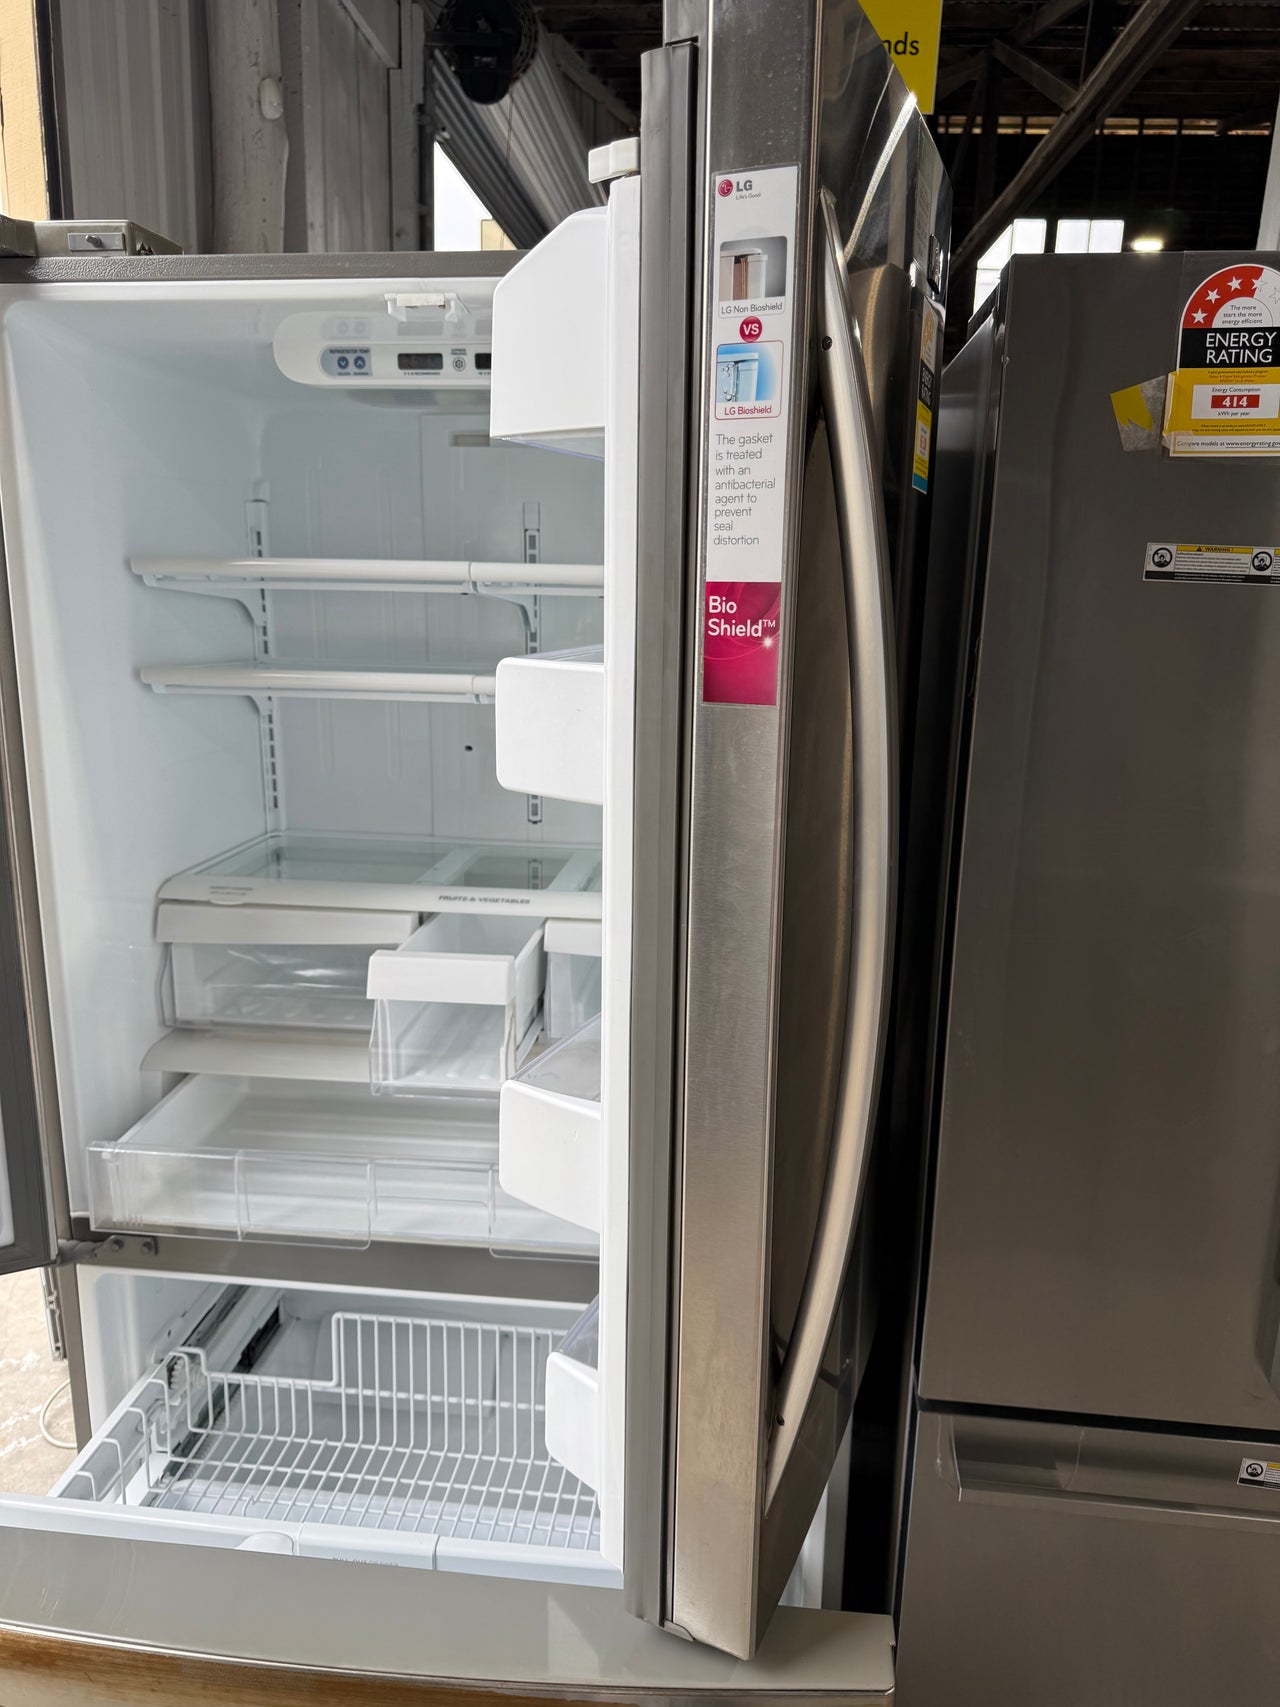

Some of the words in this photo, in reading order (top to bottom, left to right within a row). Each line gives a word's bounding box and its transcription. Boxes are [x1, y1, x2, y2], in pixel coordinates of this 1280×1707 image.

[736, 180, 753, 192] LG
[721, 306, 732, 314] LG
[733, 305, 748, 313] Non
[750, 302, 783, 312] Bioshield
[743, 323, 760, 336] VS
[1205, 331, 1277, 348] ENERGY
[1206, 348, 1273, 364] RATING
[1222, 396, 1248, 407] 414
[724, 406, 736, 416] LG
[737, 404, 772, 415] Bioshield
[715, 433, 735, 445] The
[738, 432, 773, 447] gasket
[715, 450, 724, 460] is
[726, 448, 762, 460] treated
[715, 464, 735, 475] with
[738, 466, 751, 475] an
[715, 477, 776, 490] antibacterial
[715, 493, 744, 506] agent
[747, 493, 757, 503] to
[714, 507, 752, 519] prevent
[714, 520, 733, 531] seal
[713, 534, 760, 546] distortion
[708, 595, 737, 614] Bio
[478, 896, 530, 905] VEGETABLES
